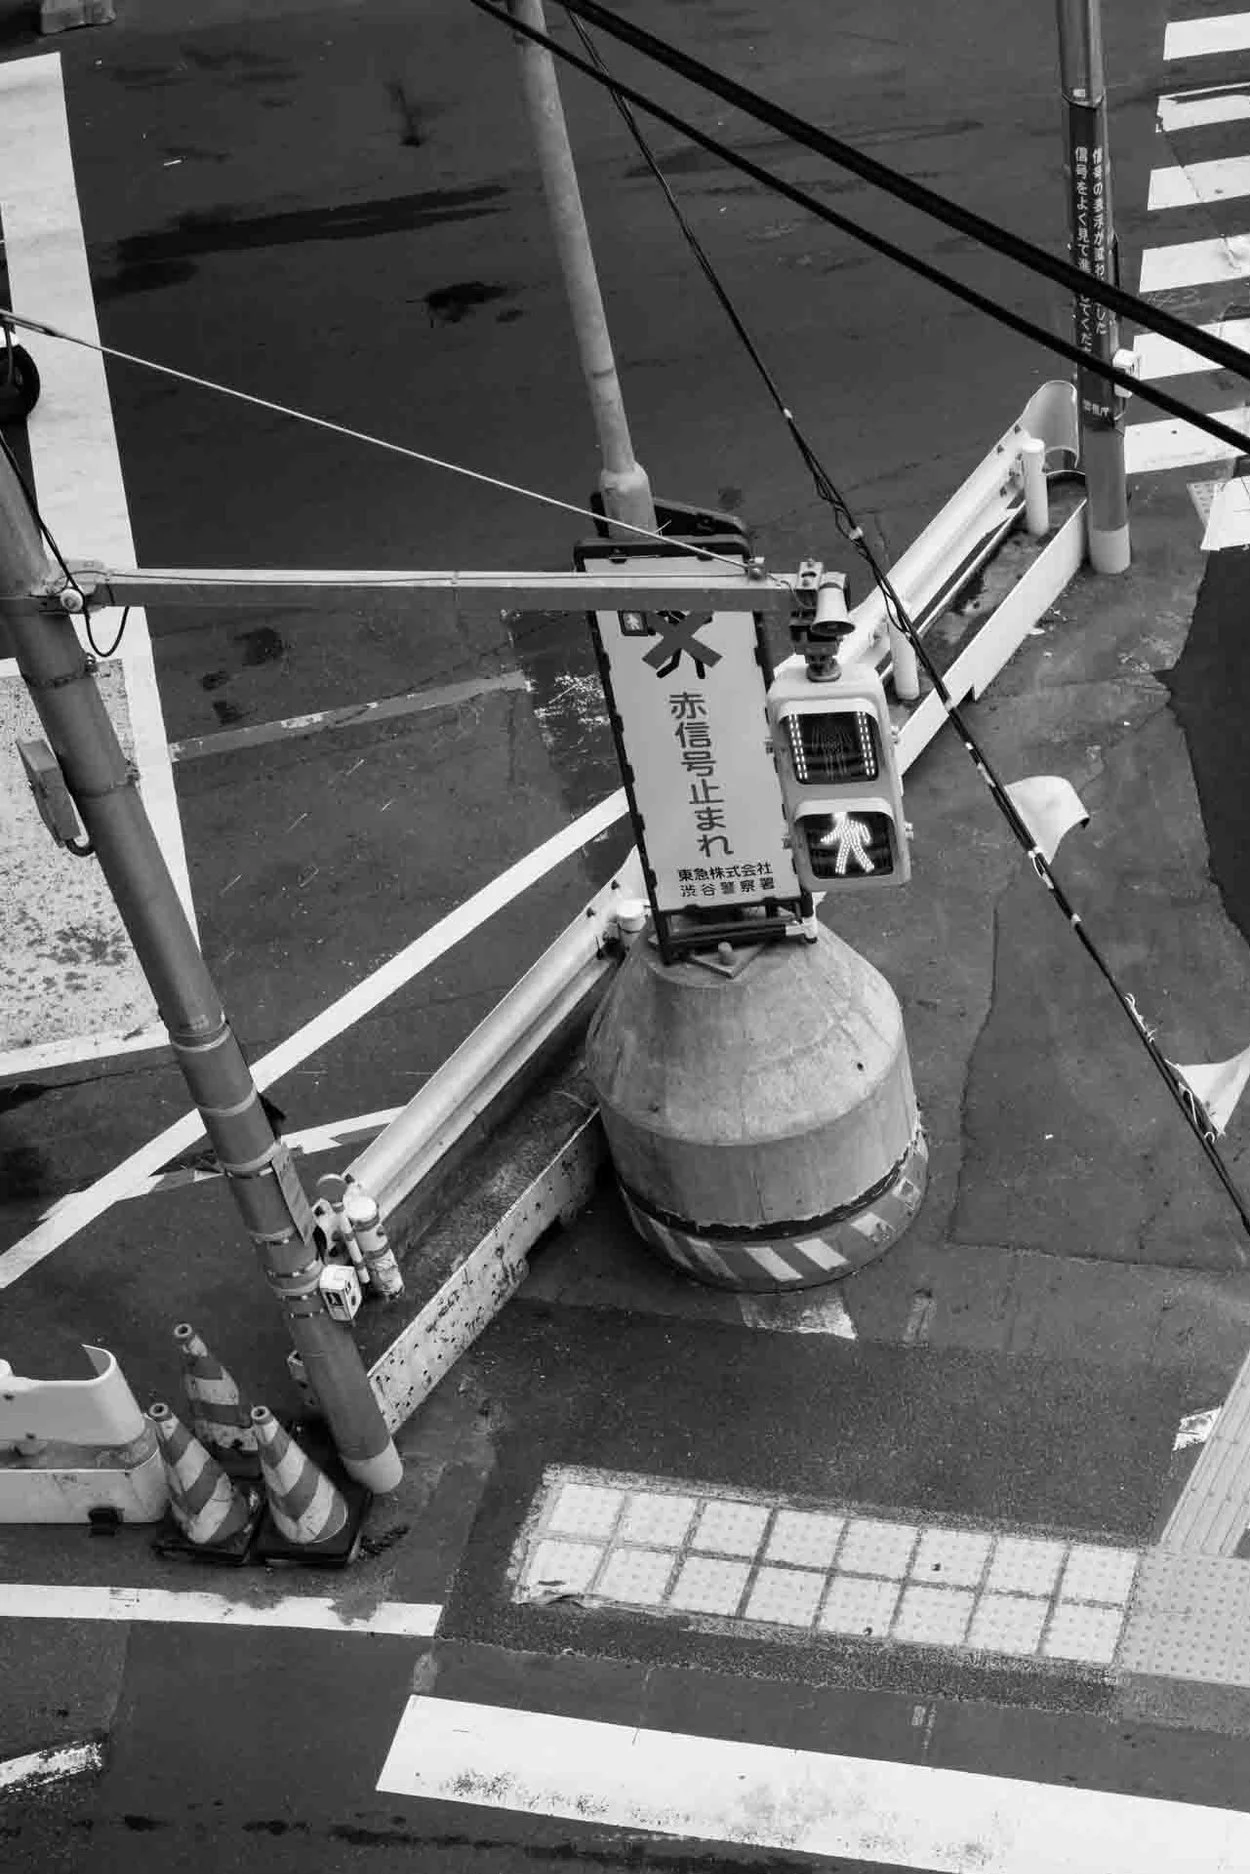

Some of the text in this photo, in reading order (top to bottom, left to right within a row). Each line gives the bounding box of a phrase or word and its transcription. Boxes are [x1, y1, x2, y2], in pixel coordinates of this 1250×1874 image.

[669, 691, 735, 857] 赤信号止まれ
[678, 862, 773, 882] 東急株式会社
[680, 877, 775, 897] 渋谷警察署
